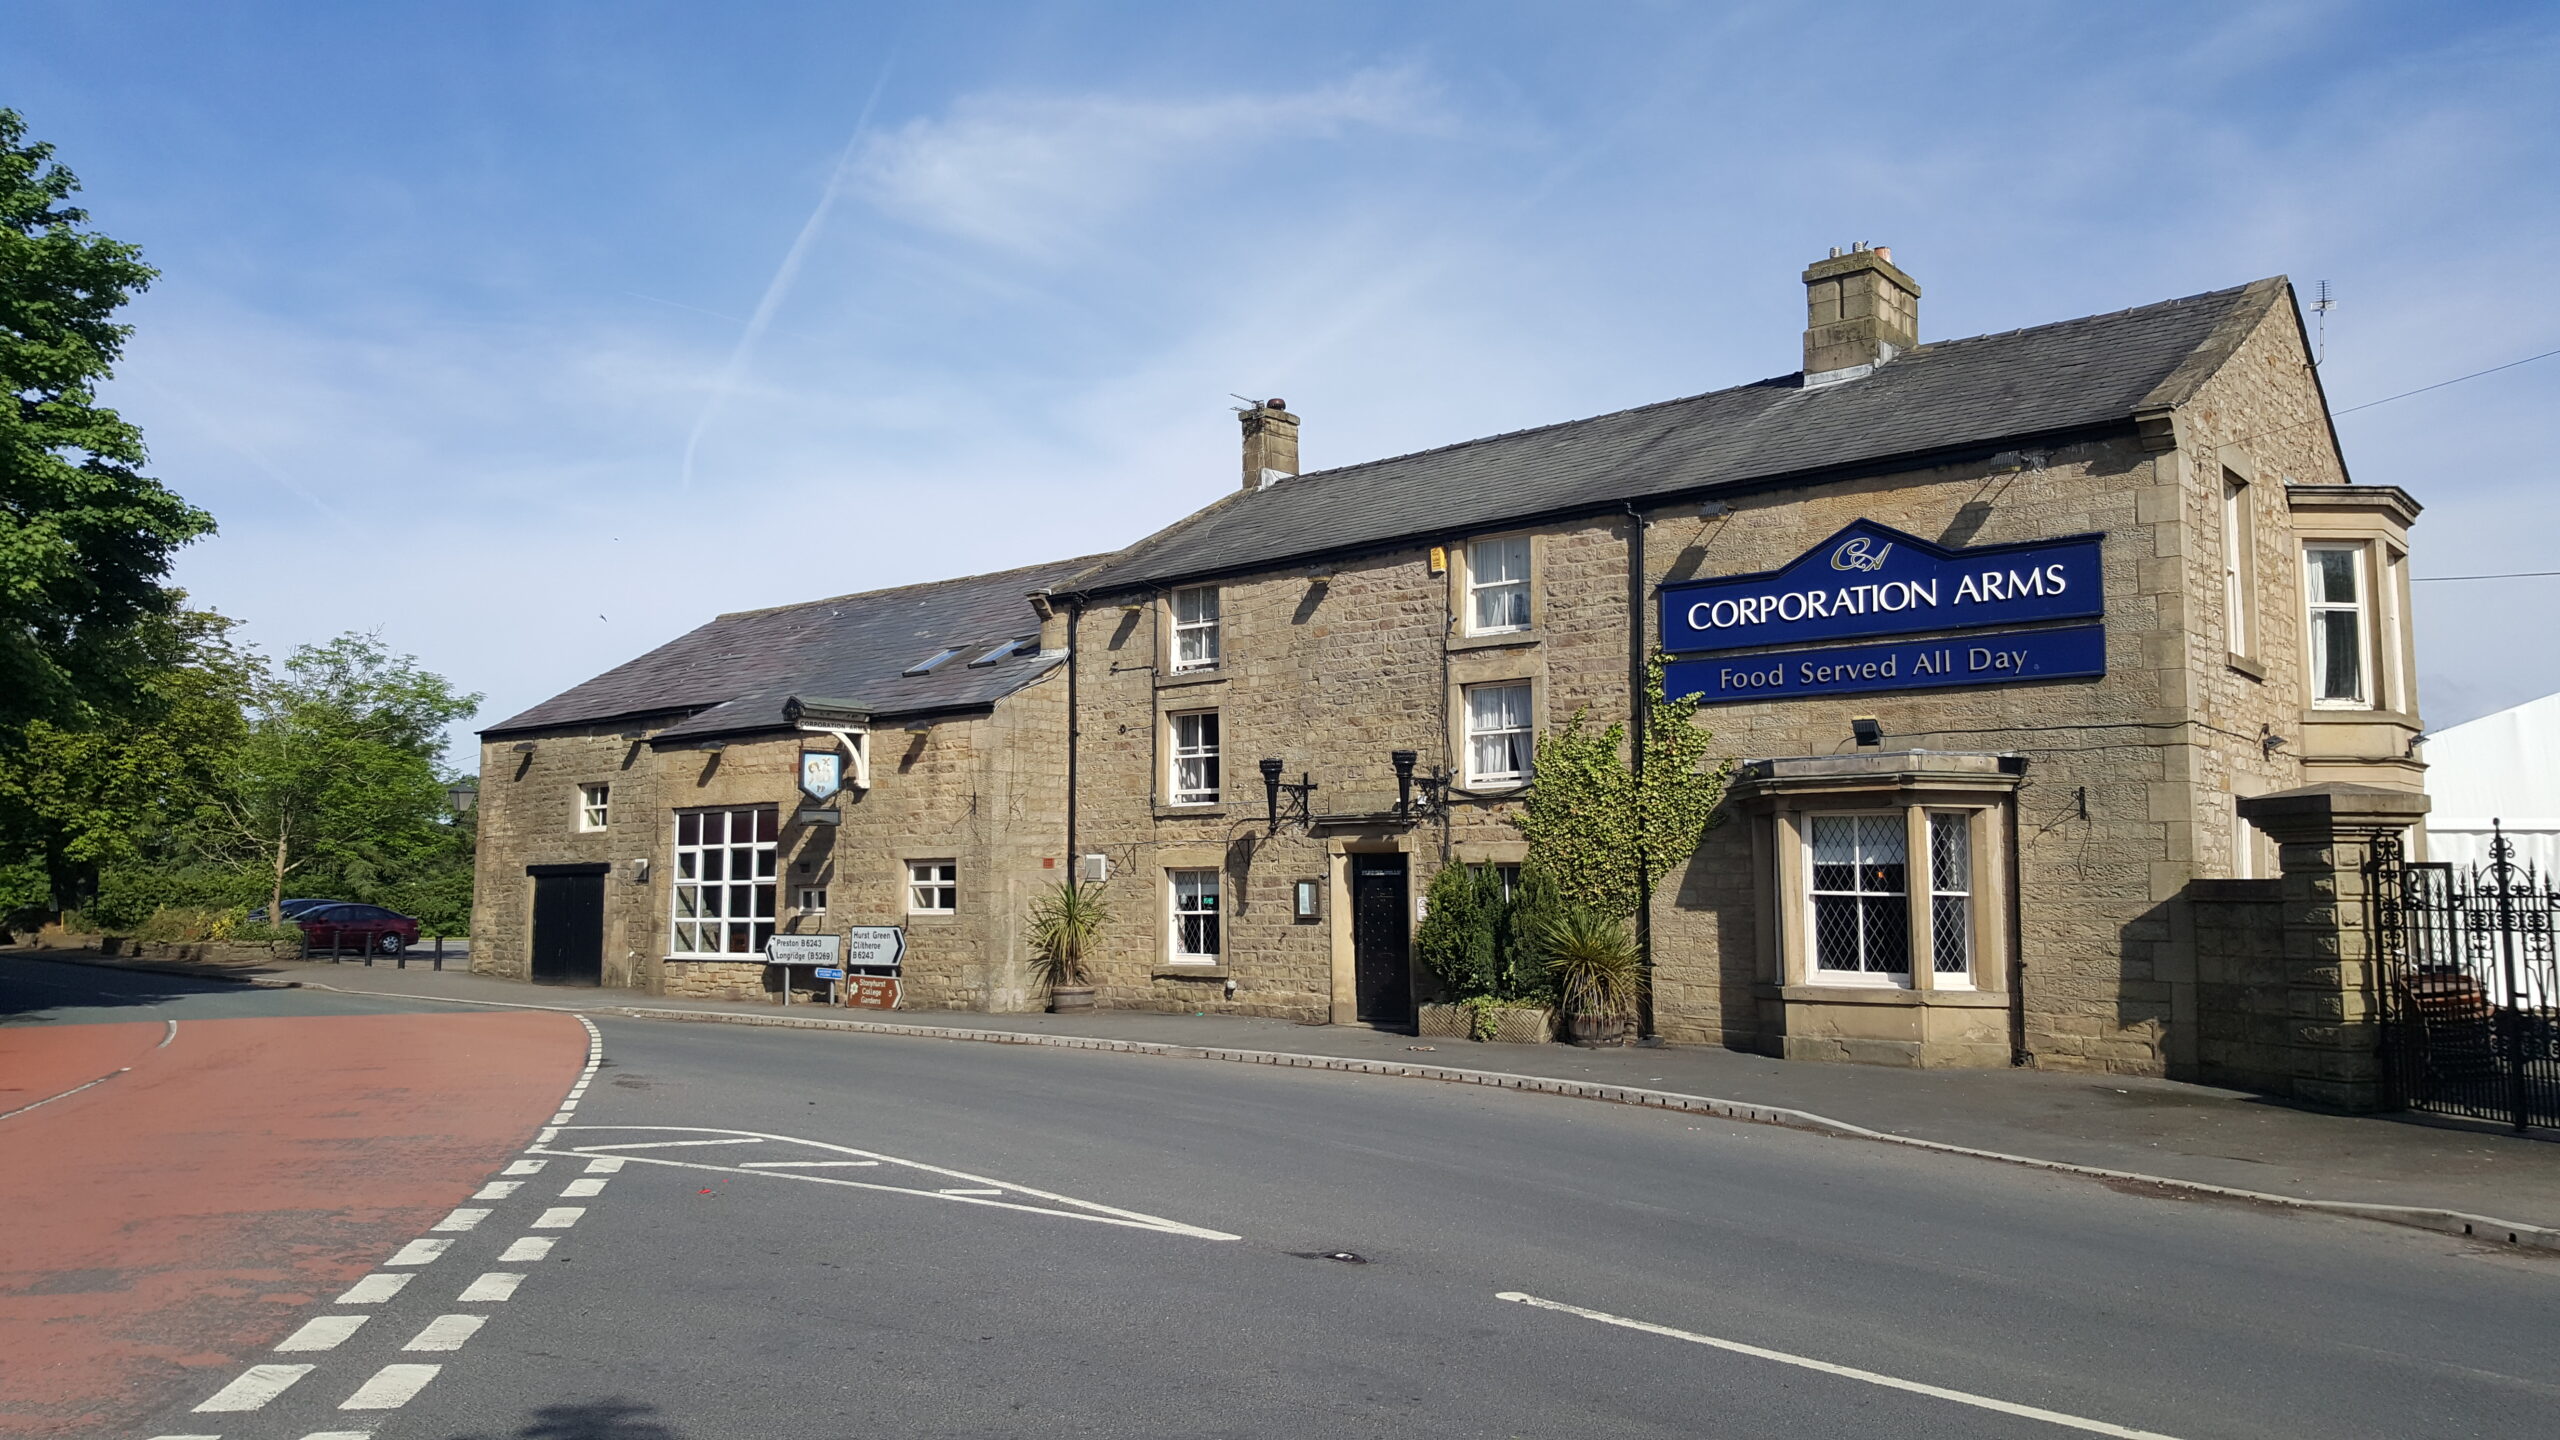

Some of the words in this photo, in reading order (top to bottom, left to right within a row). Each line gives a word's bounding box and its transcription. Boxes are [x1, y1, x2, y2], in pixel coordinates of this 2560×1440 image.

[1687, 578, 1938, 631] CORPORATION
[1953, 564, 2067, 604] ARMS
[1720, 663, 1785, 690] Food
[1800, 654, 1898, 684] Served
[1912, 649, 1952, 675] All
[1969, 647, 2028, 675] Day
[800, 720, 845, 729] CORPORATION
[853, 931, 870, 939] Hurst
[872, 931, 891, 940] Green
[776, 939, 799, 947] Preston
[853, 941, 881, 950] Clitheroe
[776, 951, 806, 961] Longridge
[862, 987, 882, 997] College
